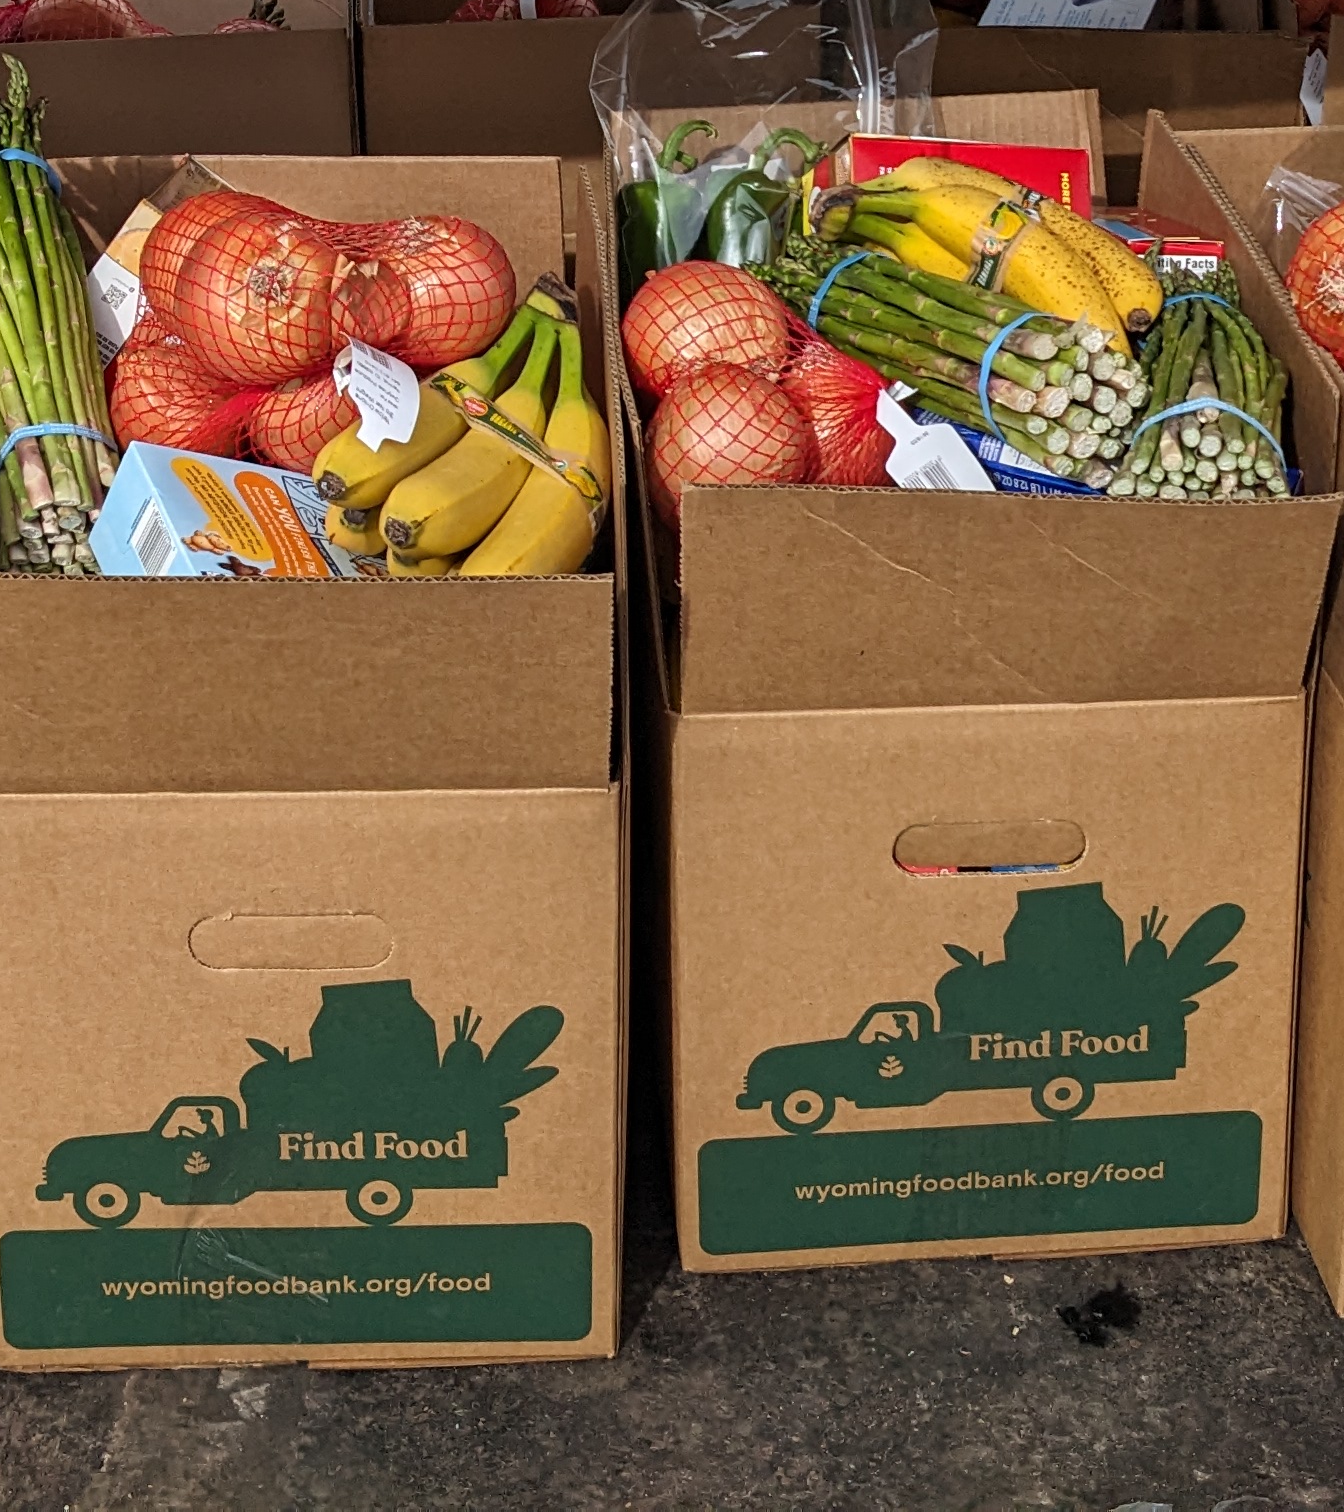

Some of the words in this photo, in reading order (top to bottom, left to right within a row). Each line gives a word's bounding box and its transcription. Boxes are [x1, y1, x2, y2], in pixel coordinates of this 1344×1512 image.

[1060, 172, 1071, 203] MORE
[1185, 257, 1217, 271] Facts
[264, 486, 281, 508] CAN
[274, 504, 301, 537] YOU
[969, 1030, 1051, 1062] Find
[1060, 1025, 1149, 1056] Food
[278, 1132, 364, 1161] Find
[373, 1129, 468, 1160] Food
[795, 1162, 1164, 1203] wyomingfoodbank.org/food
[102, 1273, 490, 1300] wyomingfoodbank.org/food
